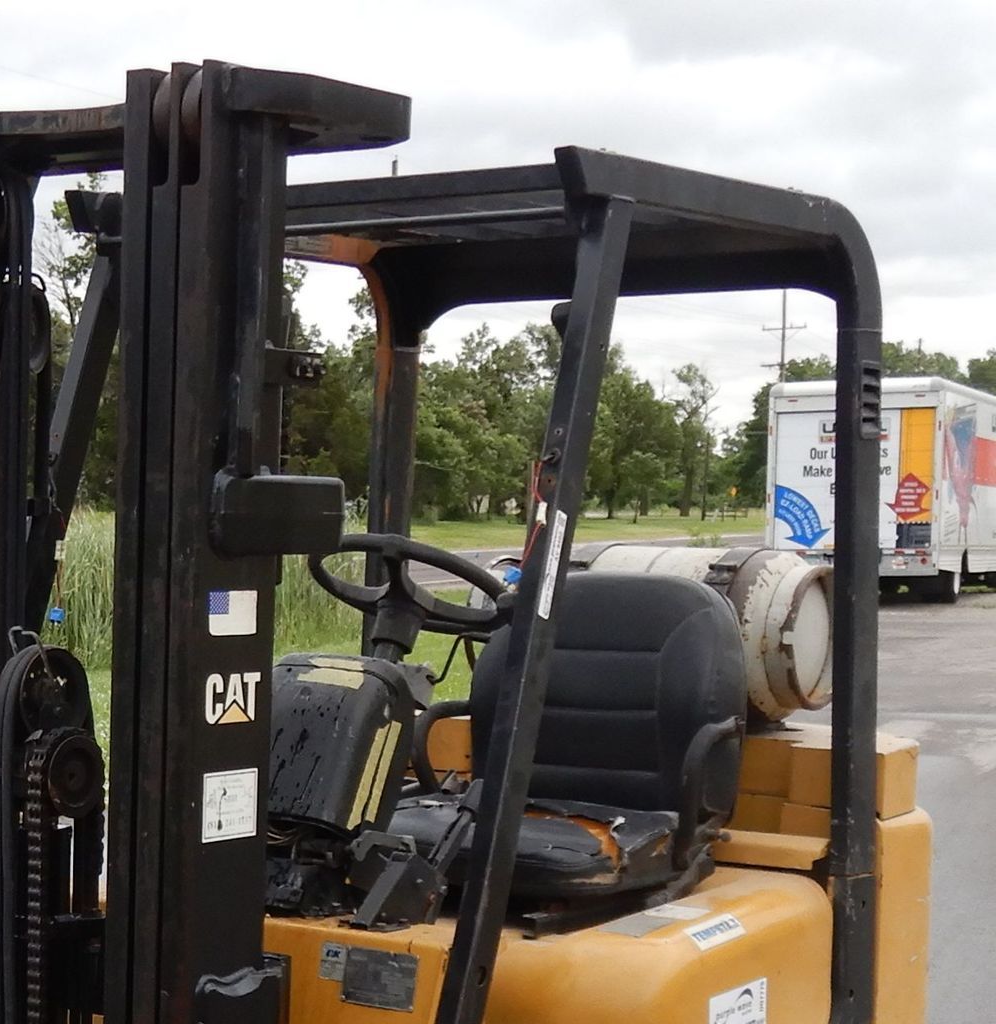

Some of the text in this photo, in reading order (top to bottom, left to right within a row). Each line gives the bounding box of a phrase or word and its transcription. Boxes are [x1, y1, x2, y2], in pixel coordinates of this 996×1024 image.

[810, 447, 828, 460] Our
[803, 465, 833, 478] Make
[206, 672, 261, 724] CAT
